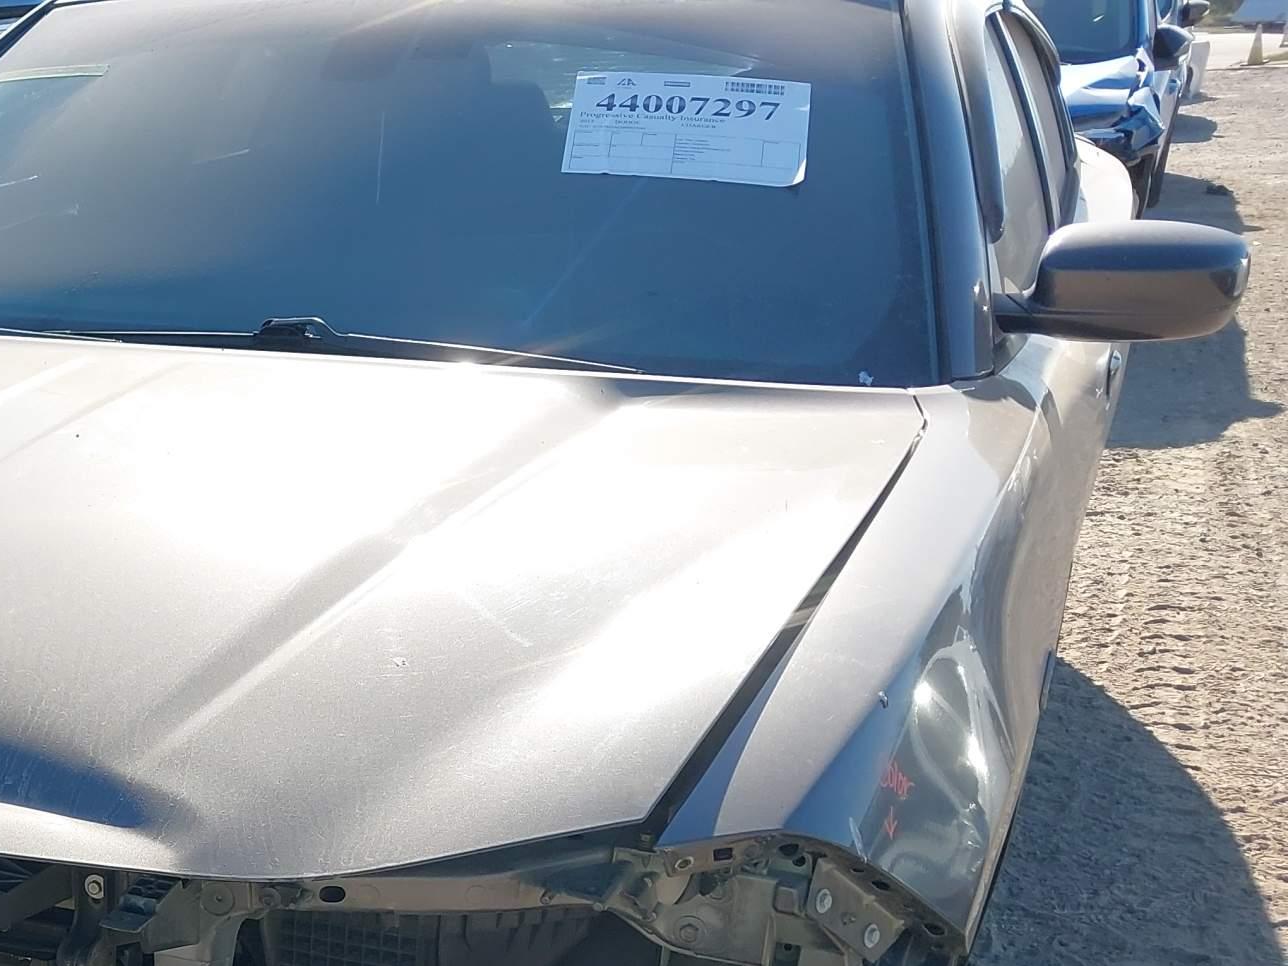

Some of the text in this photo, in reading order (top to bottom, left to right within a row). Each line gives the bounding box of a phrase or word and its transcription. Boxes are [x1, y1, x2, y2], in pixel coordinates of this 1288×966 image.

[580, 111, 726, 123] Progressive Casualty Insurance
[596, 93, 782, 121] 44007297
